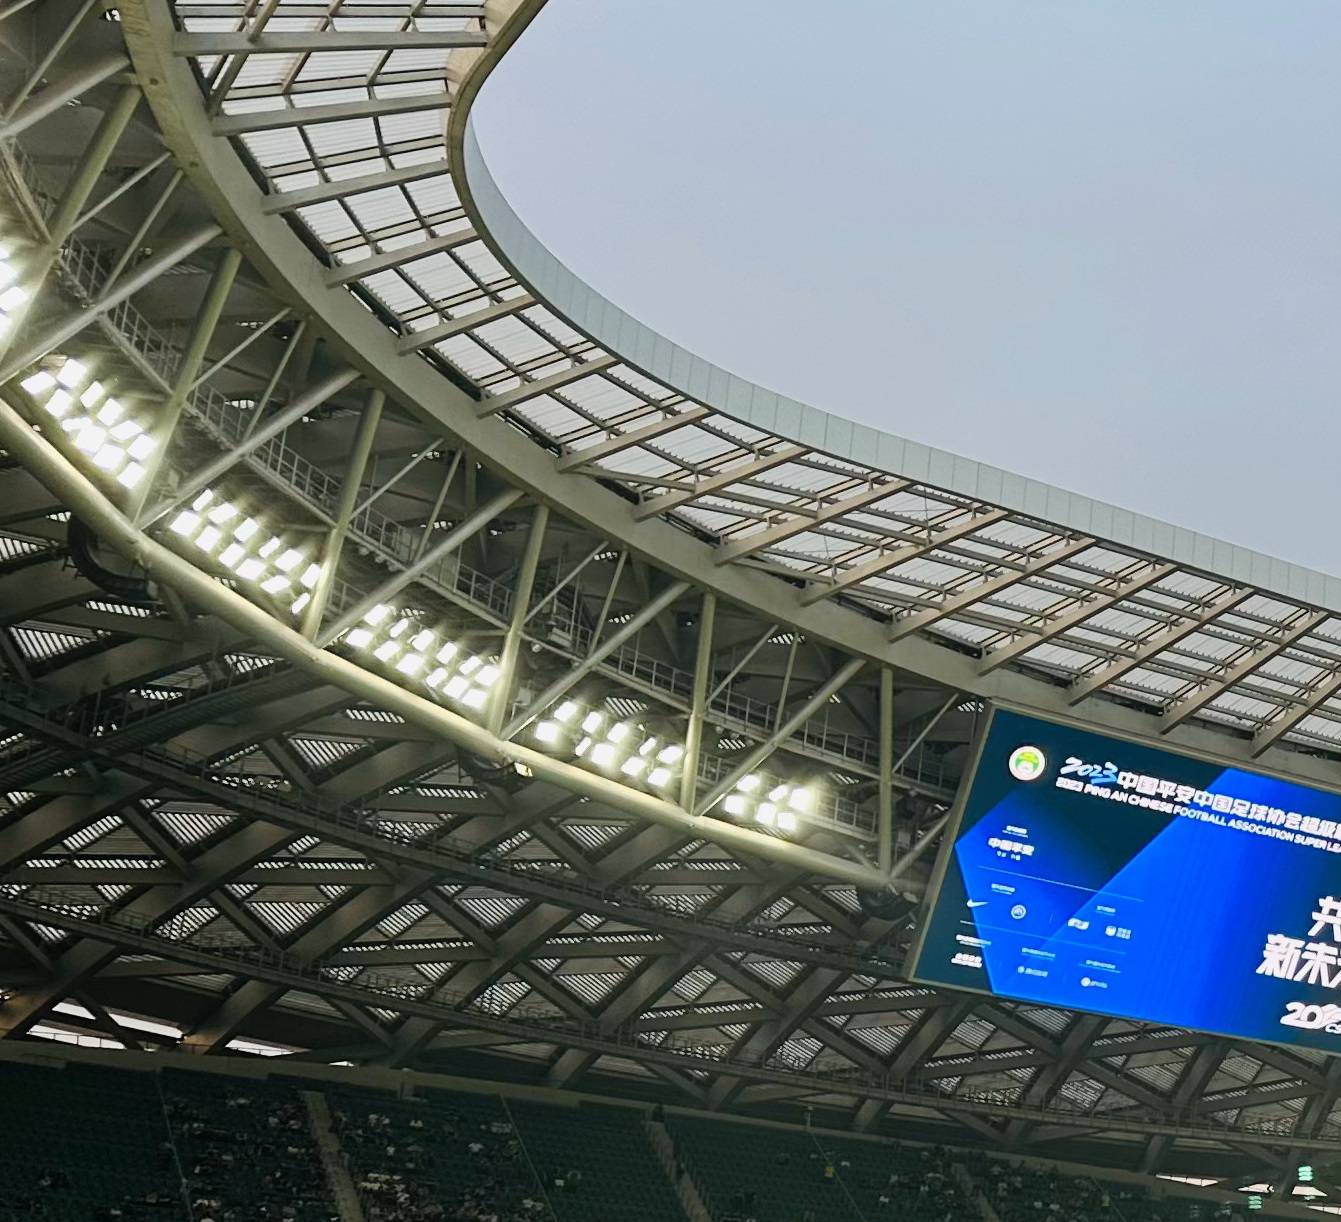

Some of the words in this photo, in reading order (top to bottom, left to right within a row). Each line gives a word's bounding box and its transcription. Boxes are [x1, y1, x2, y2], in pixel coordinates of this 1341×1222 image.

[1084, 783, 1111, 799] PING
[1111, 789, 1128, 804] AN
[1173, 805, 1227, 827] FOOTBALL
[1228, 818, 1294, 844] ASSOCIATION
[1294, 834, 1327, 851] SUPER
